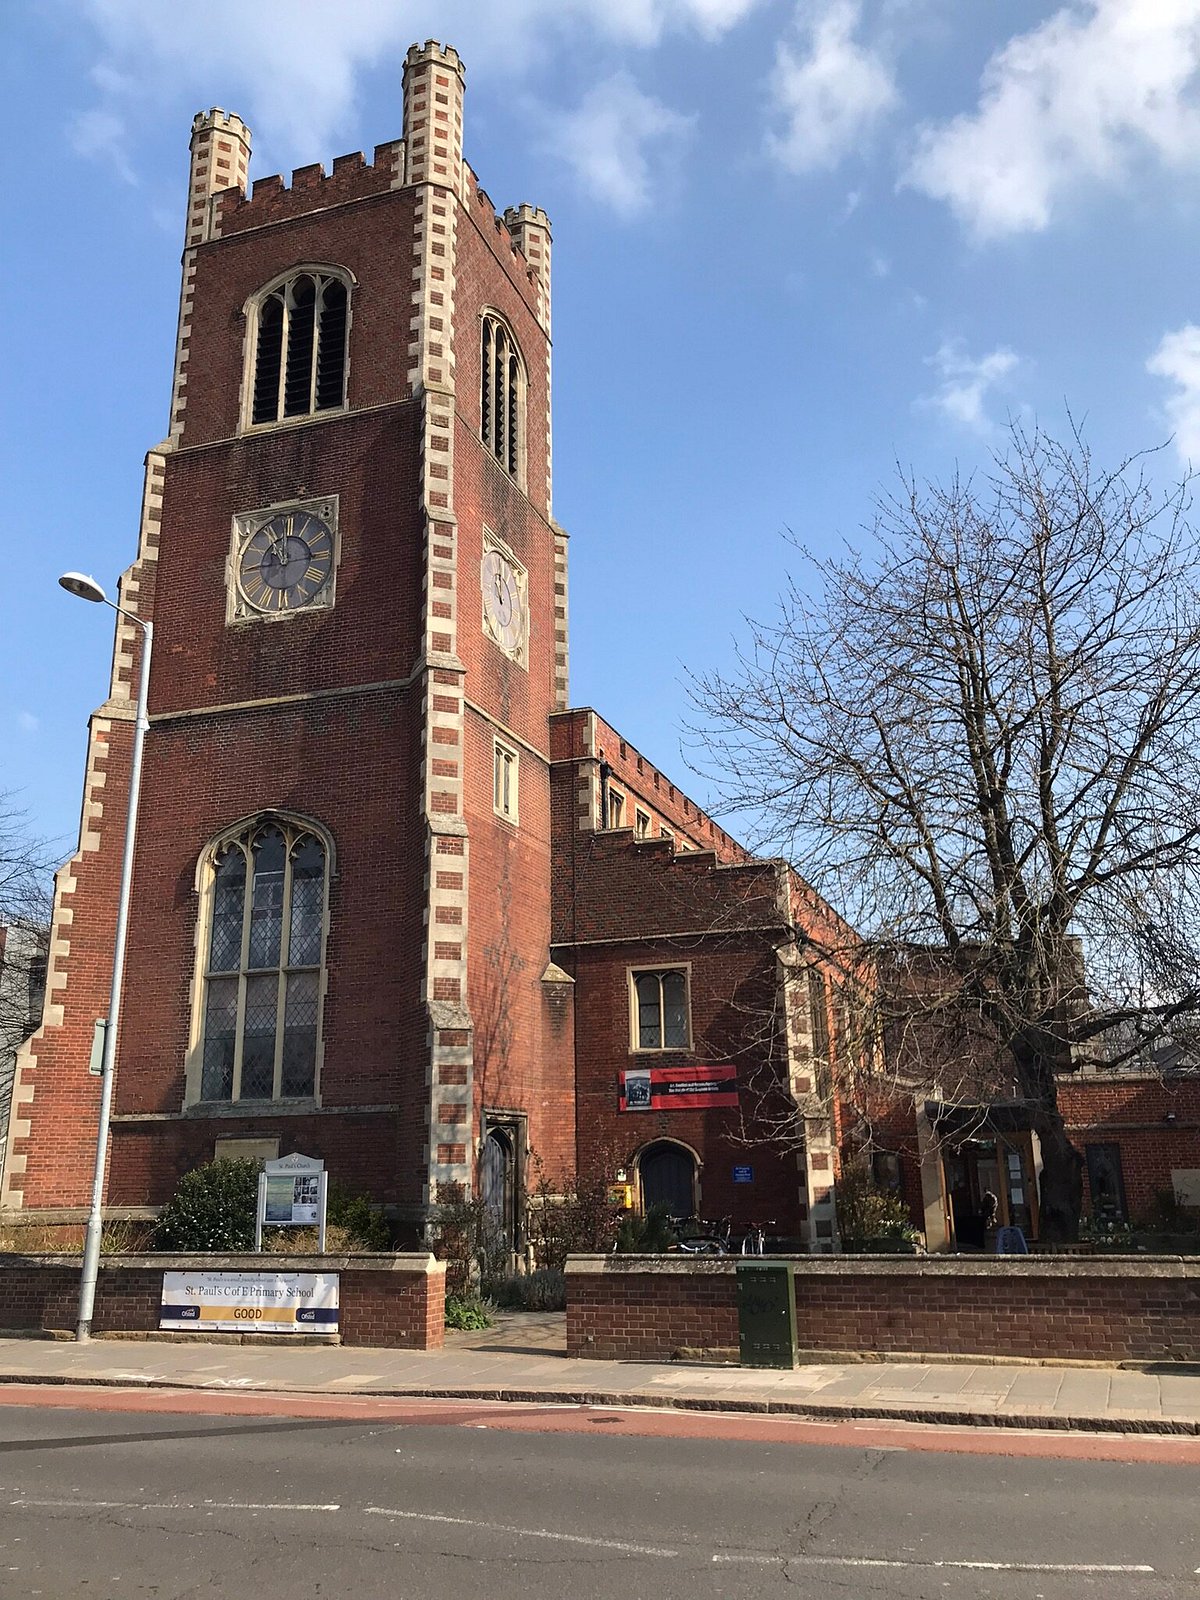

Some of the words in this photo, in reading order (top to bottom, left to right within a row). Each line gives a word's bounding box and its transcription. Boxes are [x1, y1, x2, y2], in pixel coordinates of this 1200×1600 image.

[185, 1285, 196, 1296] St.
[198, 1285, 222, 1296] Paul's
[223, 1286, 231, 1296] C
[231, 1286, 241, 1296] of
[242, 1286, 249, 1297] E
[250, 1286, 284, 1299] Primary
[286, 1287, 314, 1298] School
[234, 1308, 262, 1319] GOOD
